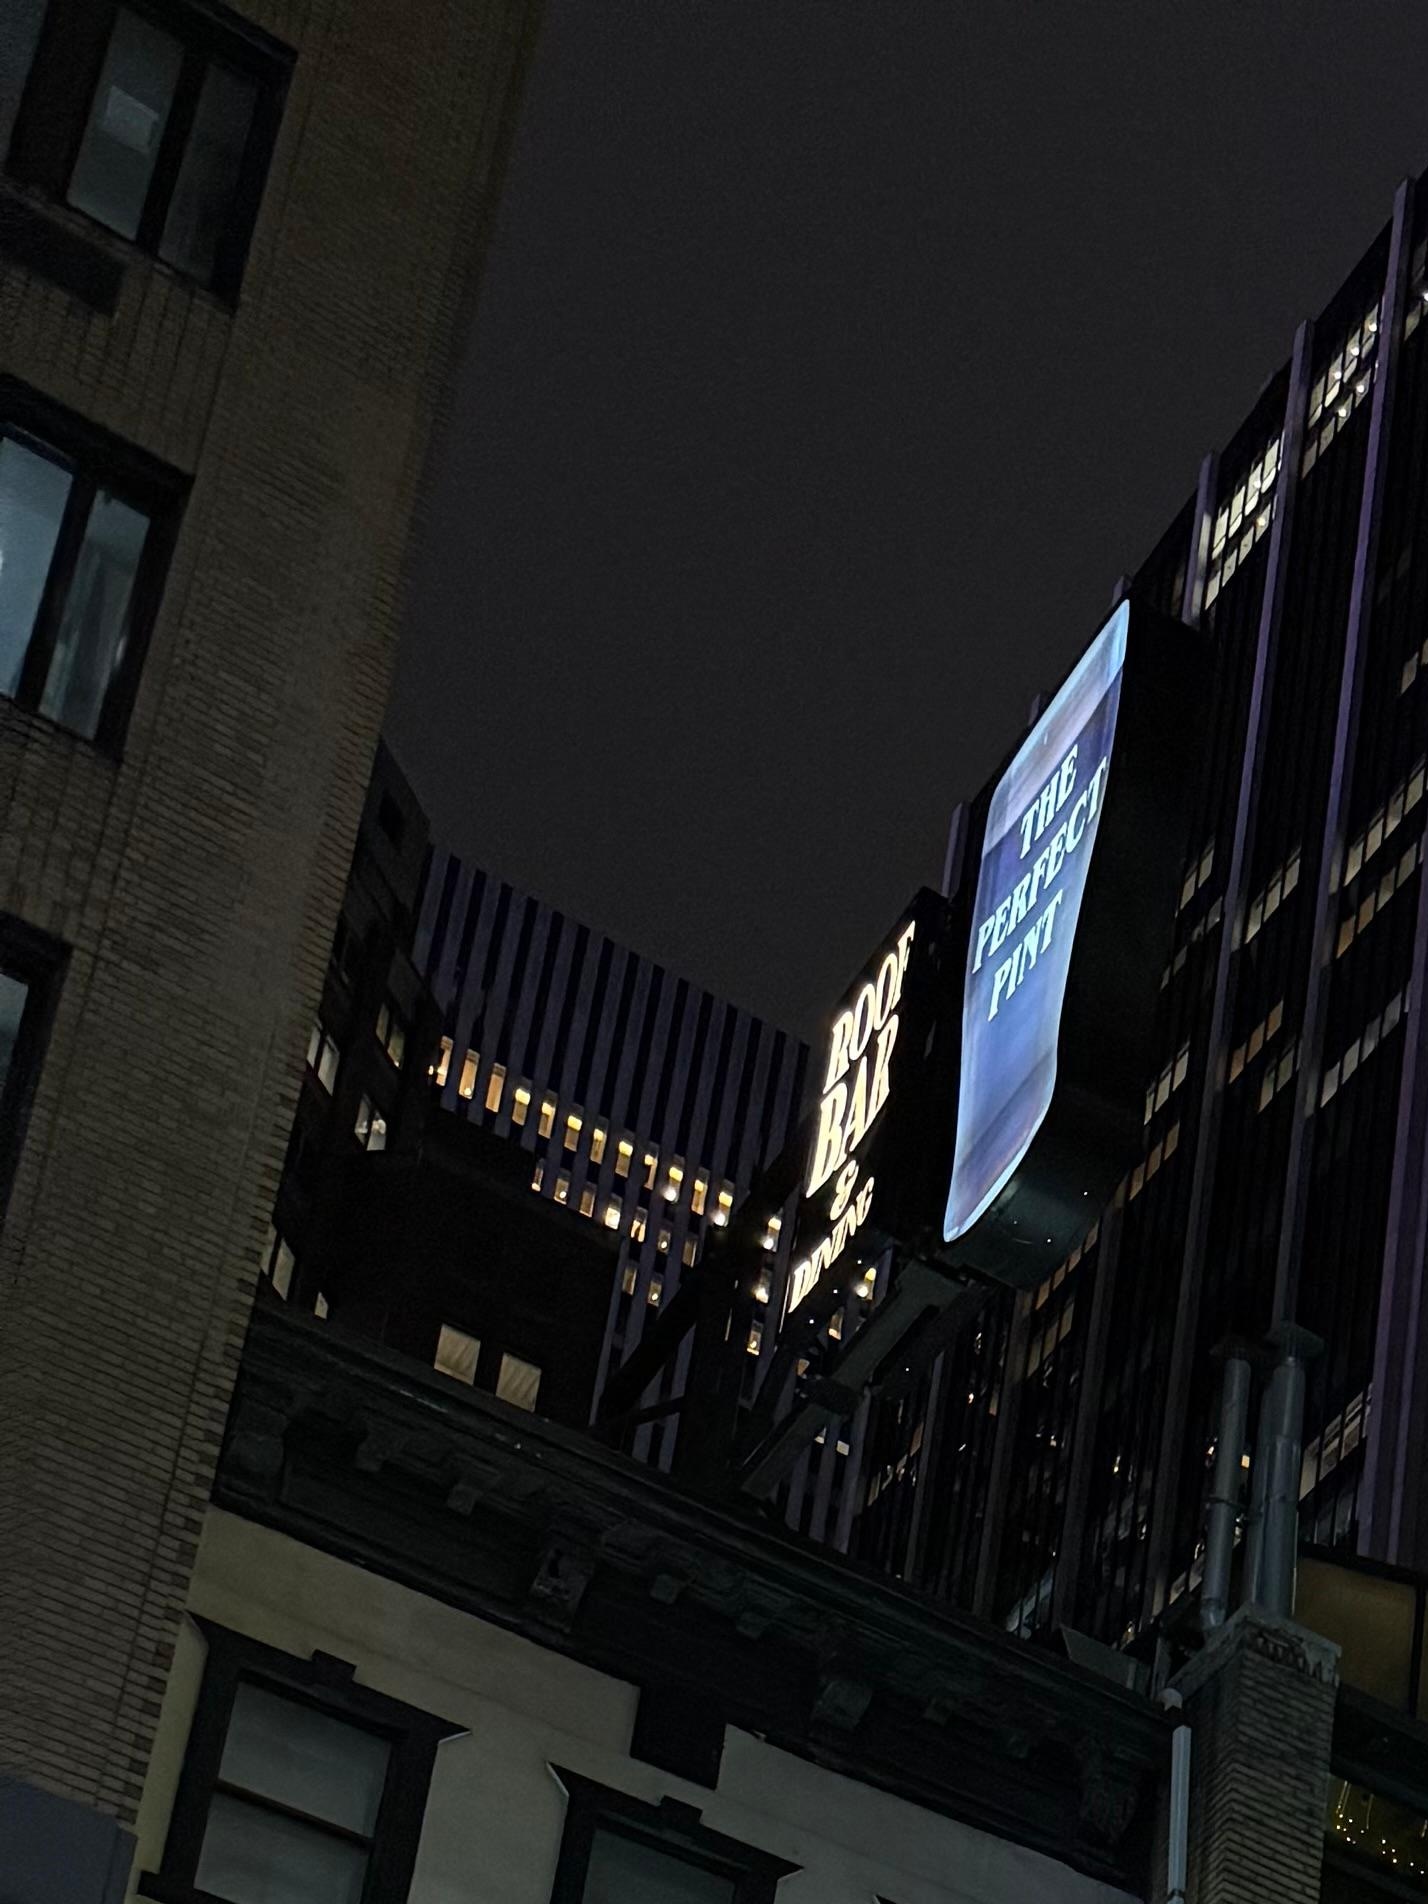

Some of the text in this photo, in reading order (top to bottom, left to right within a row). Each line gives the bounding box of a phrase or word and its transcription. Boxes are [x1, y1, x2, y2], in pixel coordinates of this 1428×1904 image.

[972, 757, 1107, 974] PERFECT
[1019, 745, 1082, 860] THE
[824, 921, 915, 1095] ROOF
[987, 890, 1063, 1022] PINT
[806, 1014, 899, 1198] BAR
[788, 1177, 875, 1314] DINING
[829, 1160, 859, 1221] &
